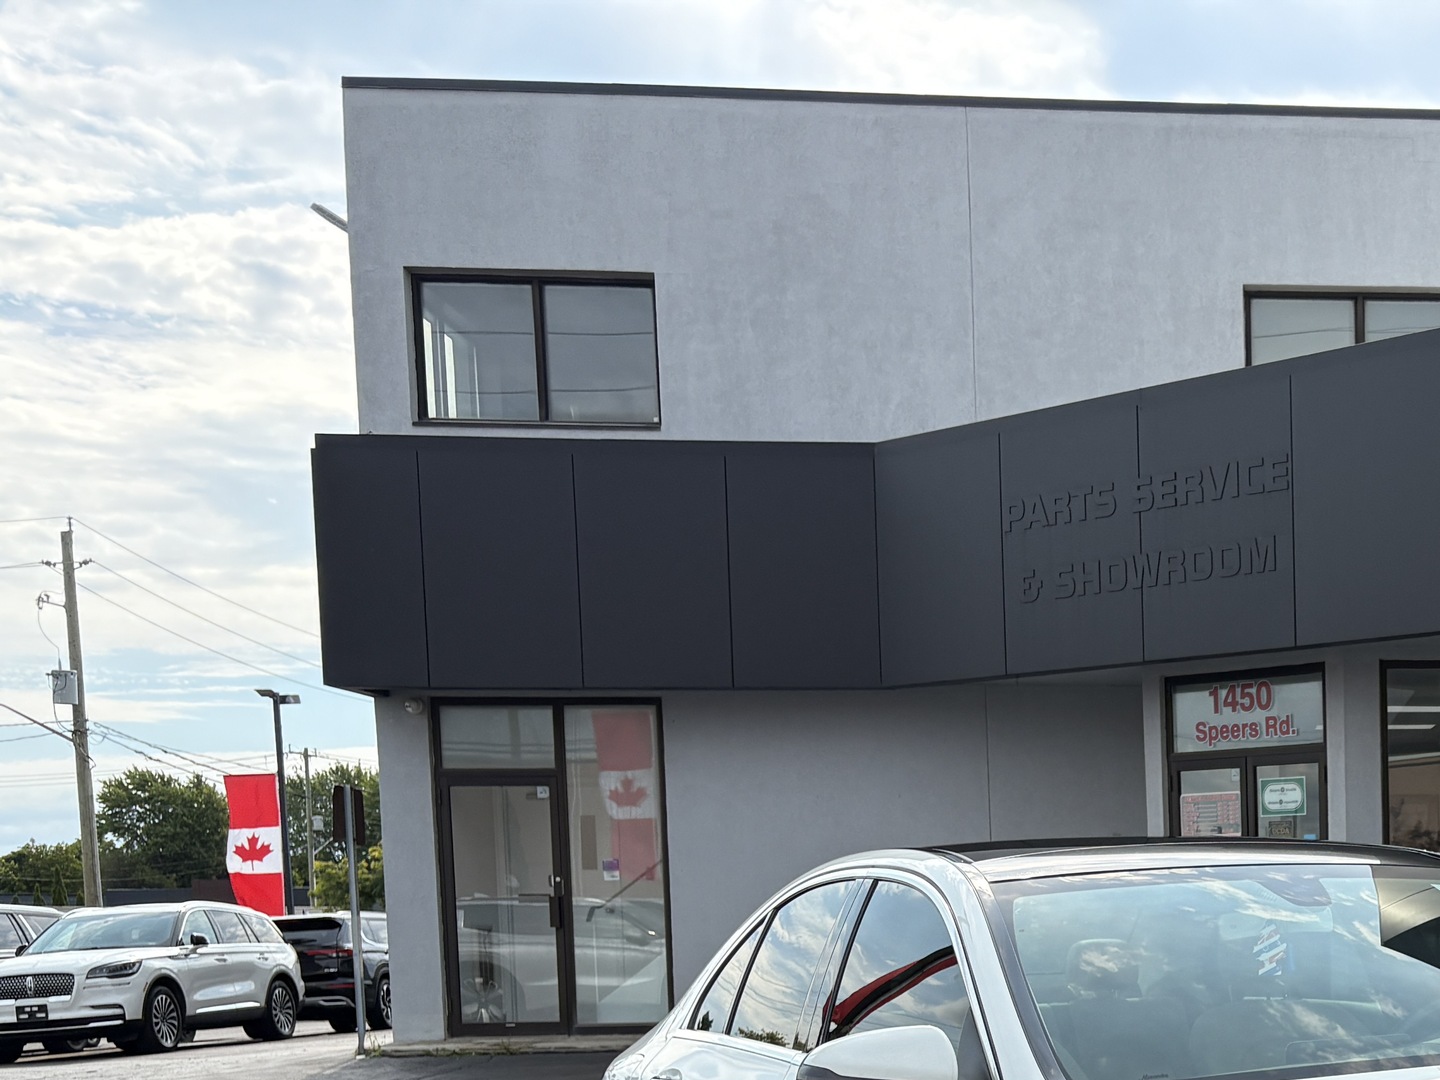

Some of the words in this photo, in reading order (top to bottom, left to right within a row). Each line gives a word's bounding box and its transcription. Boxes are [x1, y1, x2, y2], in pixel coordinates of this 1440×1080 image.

[1004, 482, 1117, 534] PARTS
[1133, 453, 1290, 514] SERVICE
[1021, 568, 1044, 604] &
[1055, 535, 1277, 600] SHOWROOM
[1208, 680, 1272, 714] 1450
[1195, 721, 1260, 748] Speers
[1264, 714, 1298, 738] Rd.
